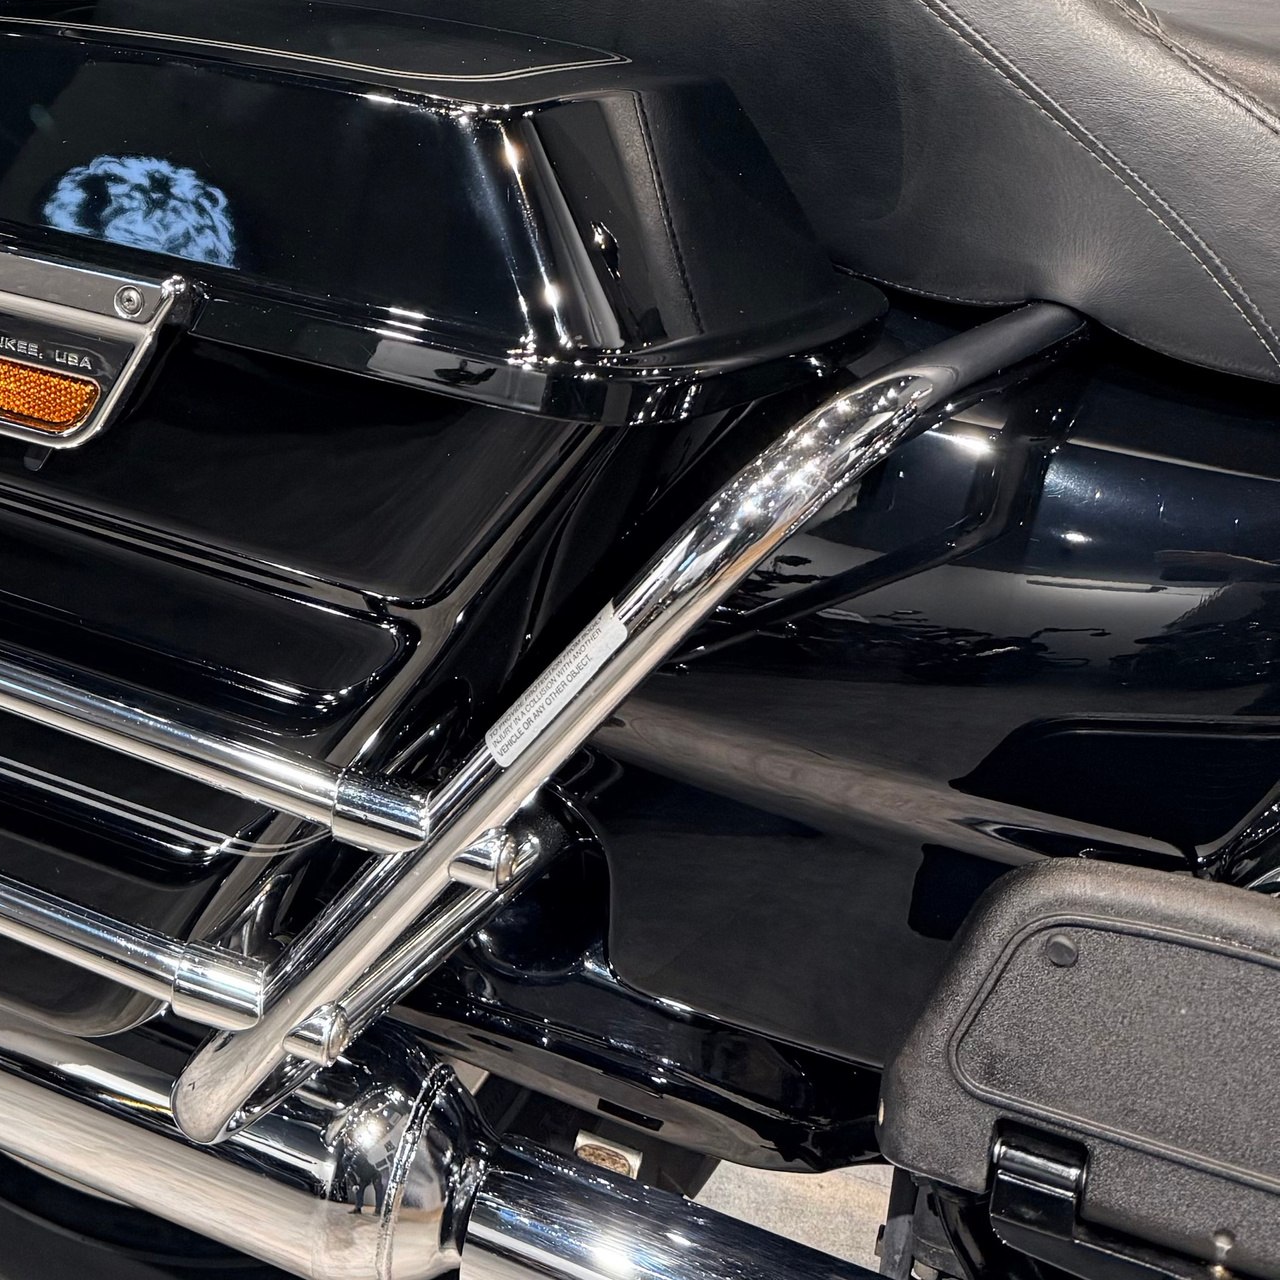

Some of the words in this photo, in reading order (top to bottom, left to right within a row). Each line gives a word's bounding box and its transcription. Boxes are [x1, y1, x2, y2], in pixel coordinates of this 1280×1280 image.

[54, 349, 93, 371] USA
[491, 723, 515, 748] INJURY
[512, 715, 522, 725] IN
[518, 710, 526, 718] A
[523, 675, 559, 713] COLLISION
[555, 658, 574, 678] WITH
[571, 627, 603, 661] ANOTHER
[496, 727, 525, 757] VEHICLE
[521, 717, 534, 731] OR
[530, 703, 548, 721] ANY
[543, 680, 568, 706] OTHER
